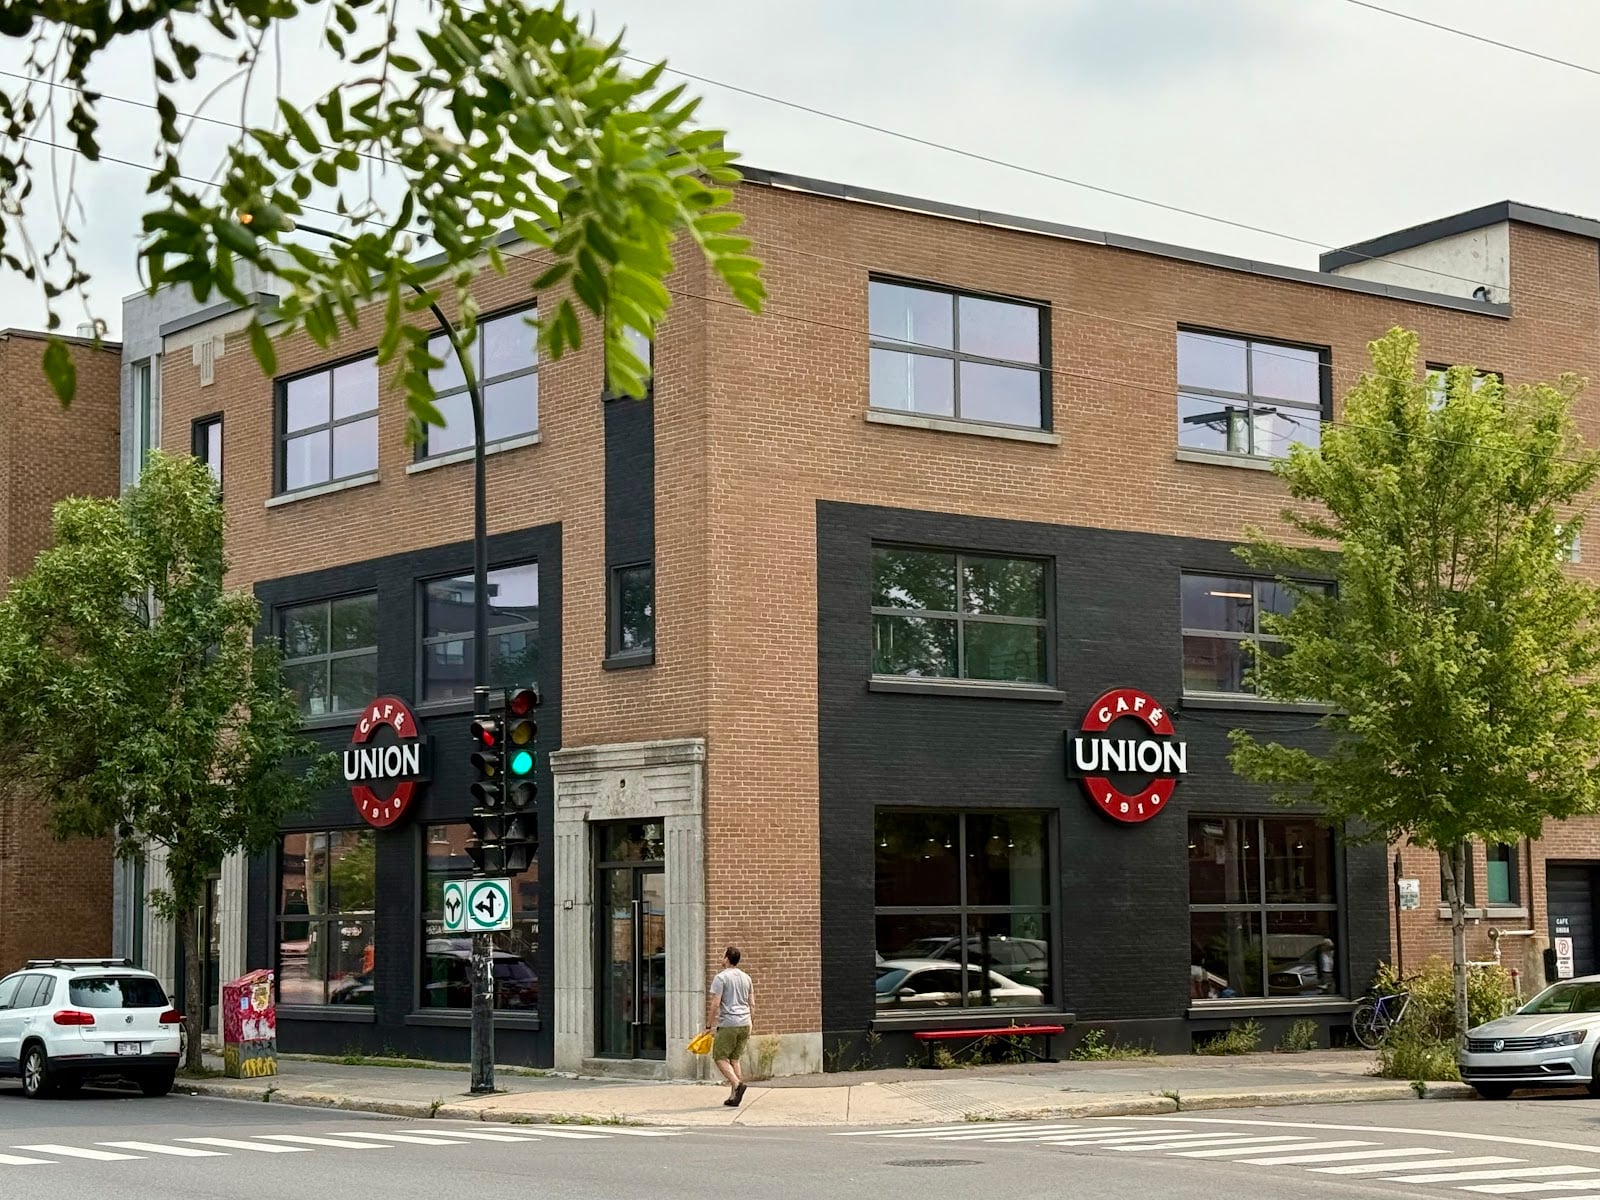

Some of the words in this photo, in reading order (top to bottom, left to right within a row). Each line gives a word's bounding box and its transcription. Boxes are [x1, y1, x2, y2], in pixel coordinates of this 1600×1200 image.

[343, 743, 420, 781] UNION
[1074, 737, 1188, 774] UNION
[362, 797, 401, 819] 1910
[1104, 792, 1161, 815] 1910
